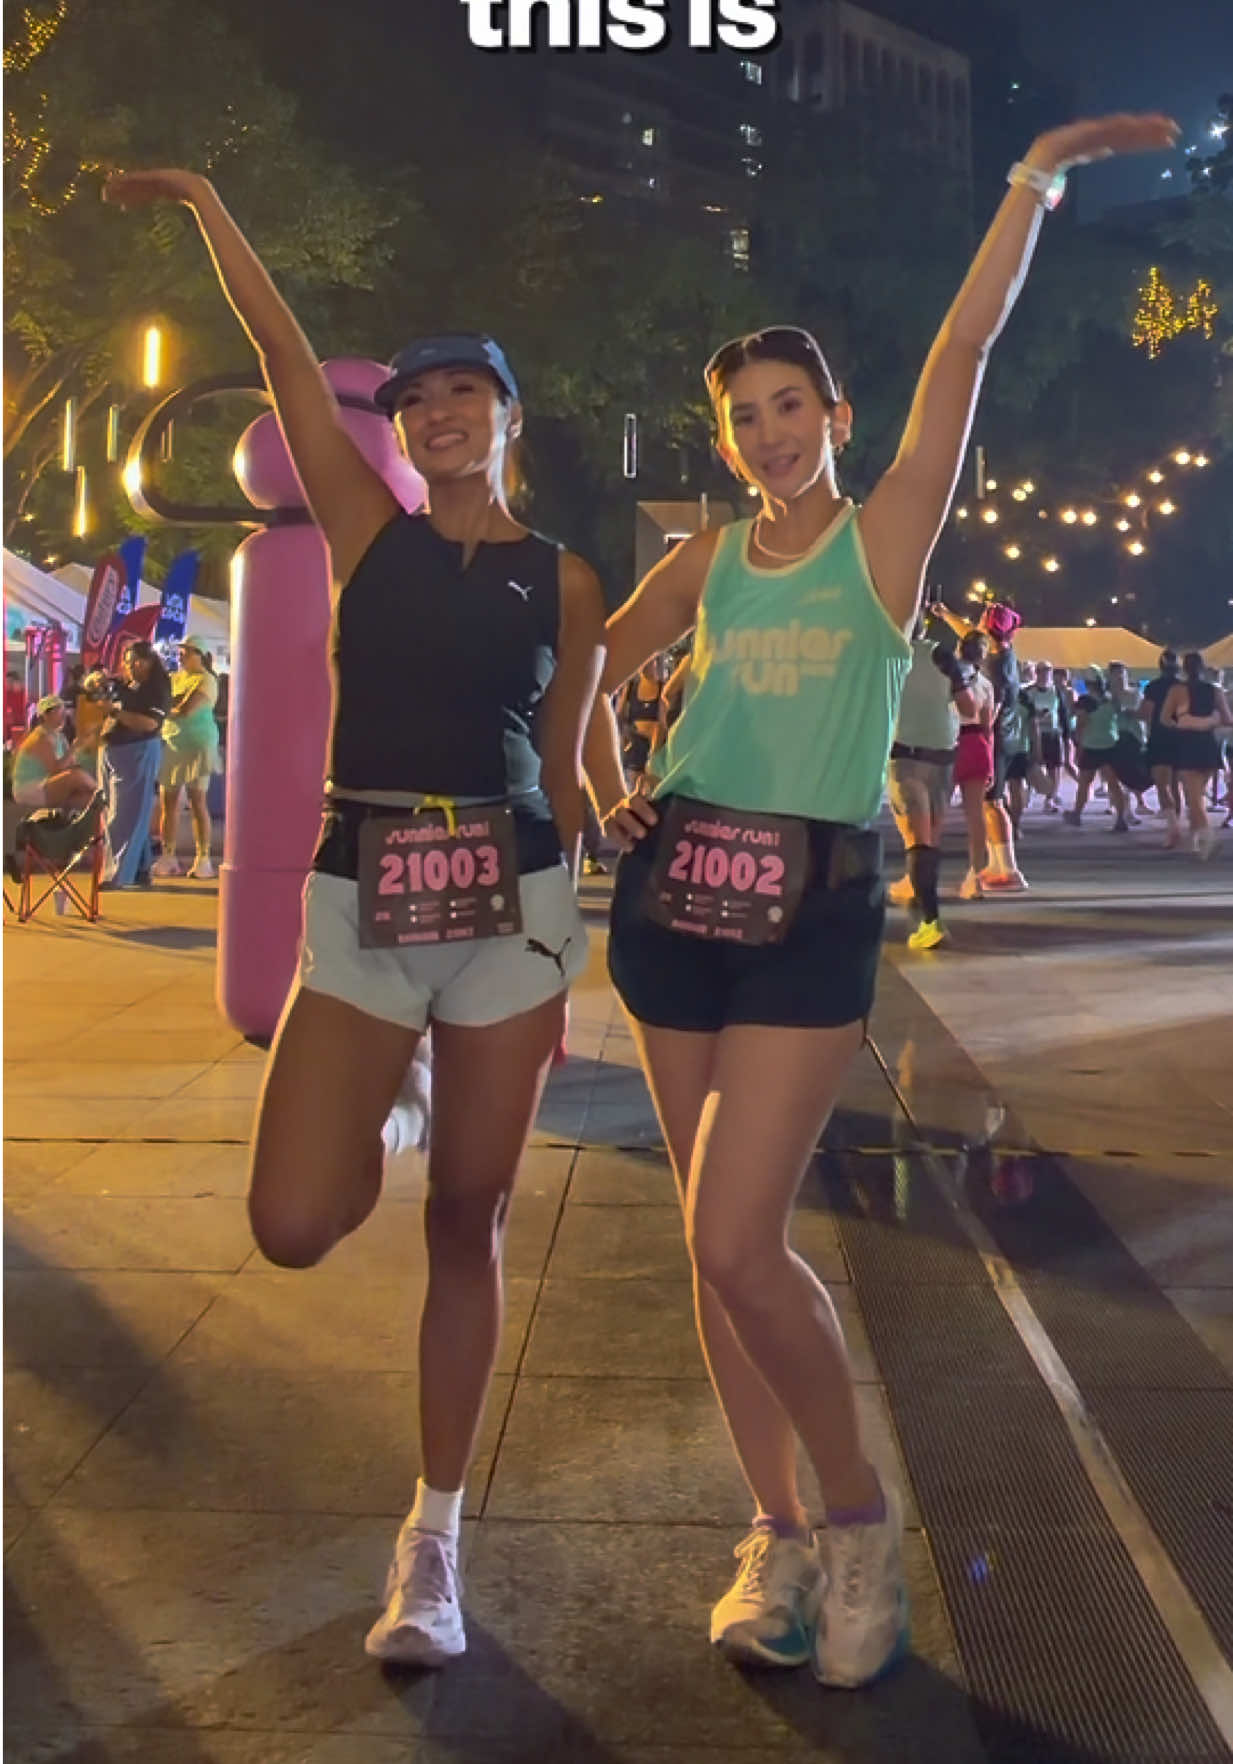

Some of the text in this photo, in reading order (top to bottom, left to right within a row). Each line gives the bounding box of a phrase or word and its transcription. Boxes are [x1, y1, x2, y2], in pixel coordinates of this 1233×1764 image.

[707, 619, 854, 662] unnier
[378, 846, 500, 895] 21003
[668, 839, 785, 896] 21002
